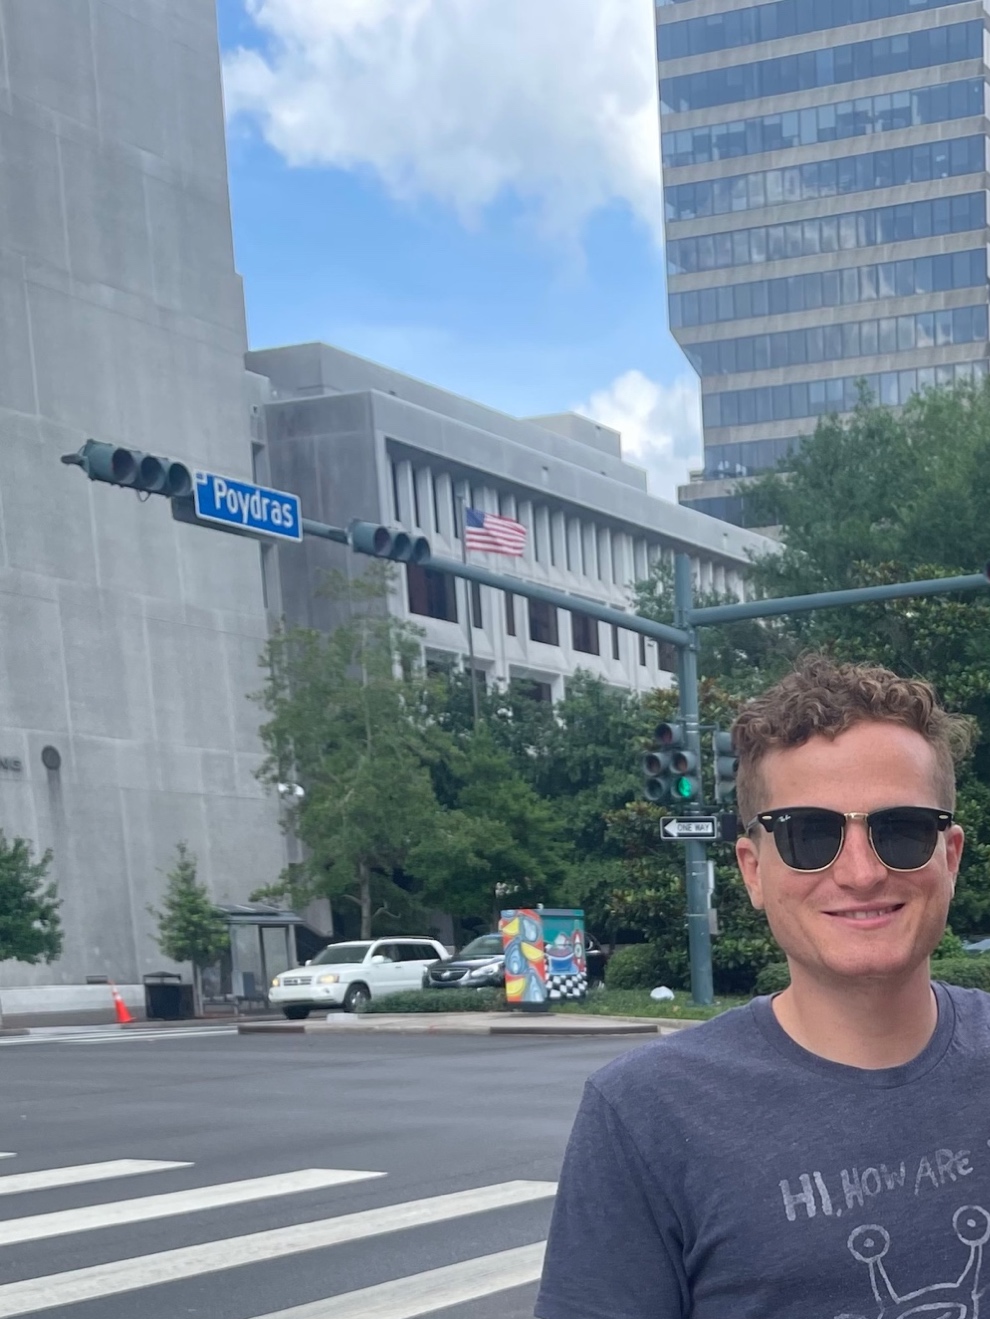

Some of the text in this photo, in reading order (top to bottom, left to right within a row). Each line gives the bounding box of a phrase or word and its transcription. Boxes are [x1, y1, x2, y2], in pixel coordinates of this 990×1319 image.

[212, 478, 294, 529] Poydras
[677, 823, 710, 832] ONE WAY
[840, 1160, 907, 1210] HOW
[914, 1148, 974, 1197] ARE
